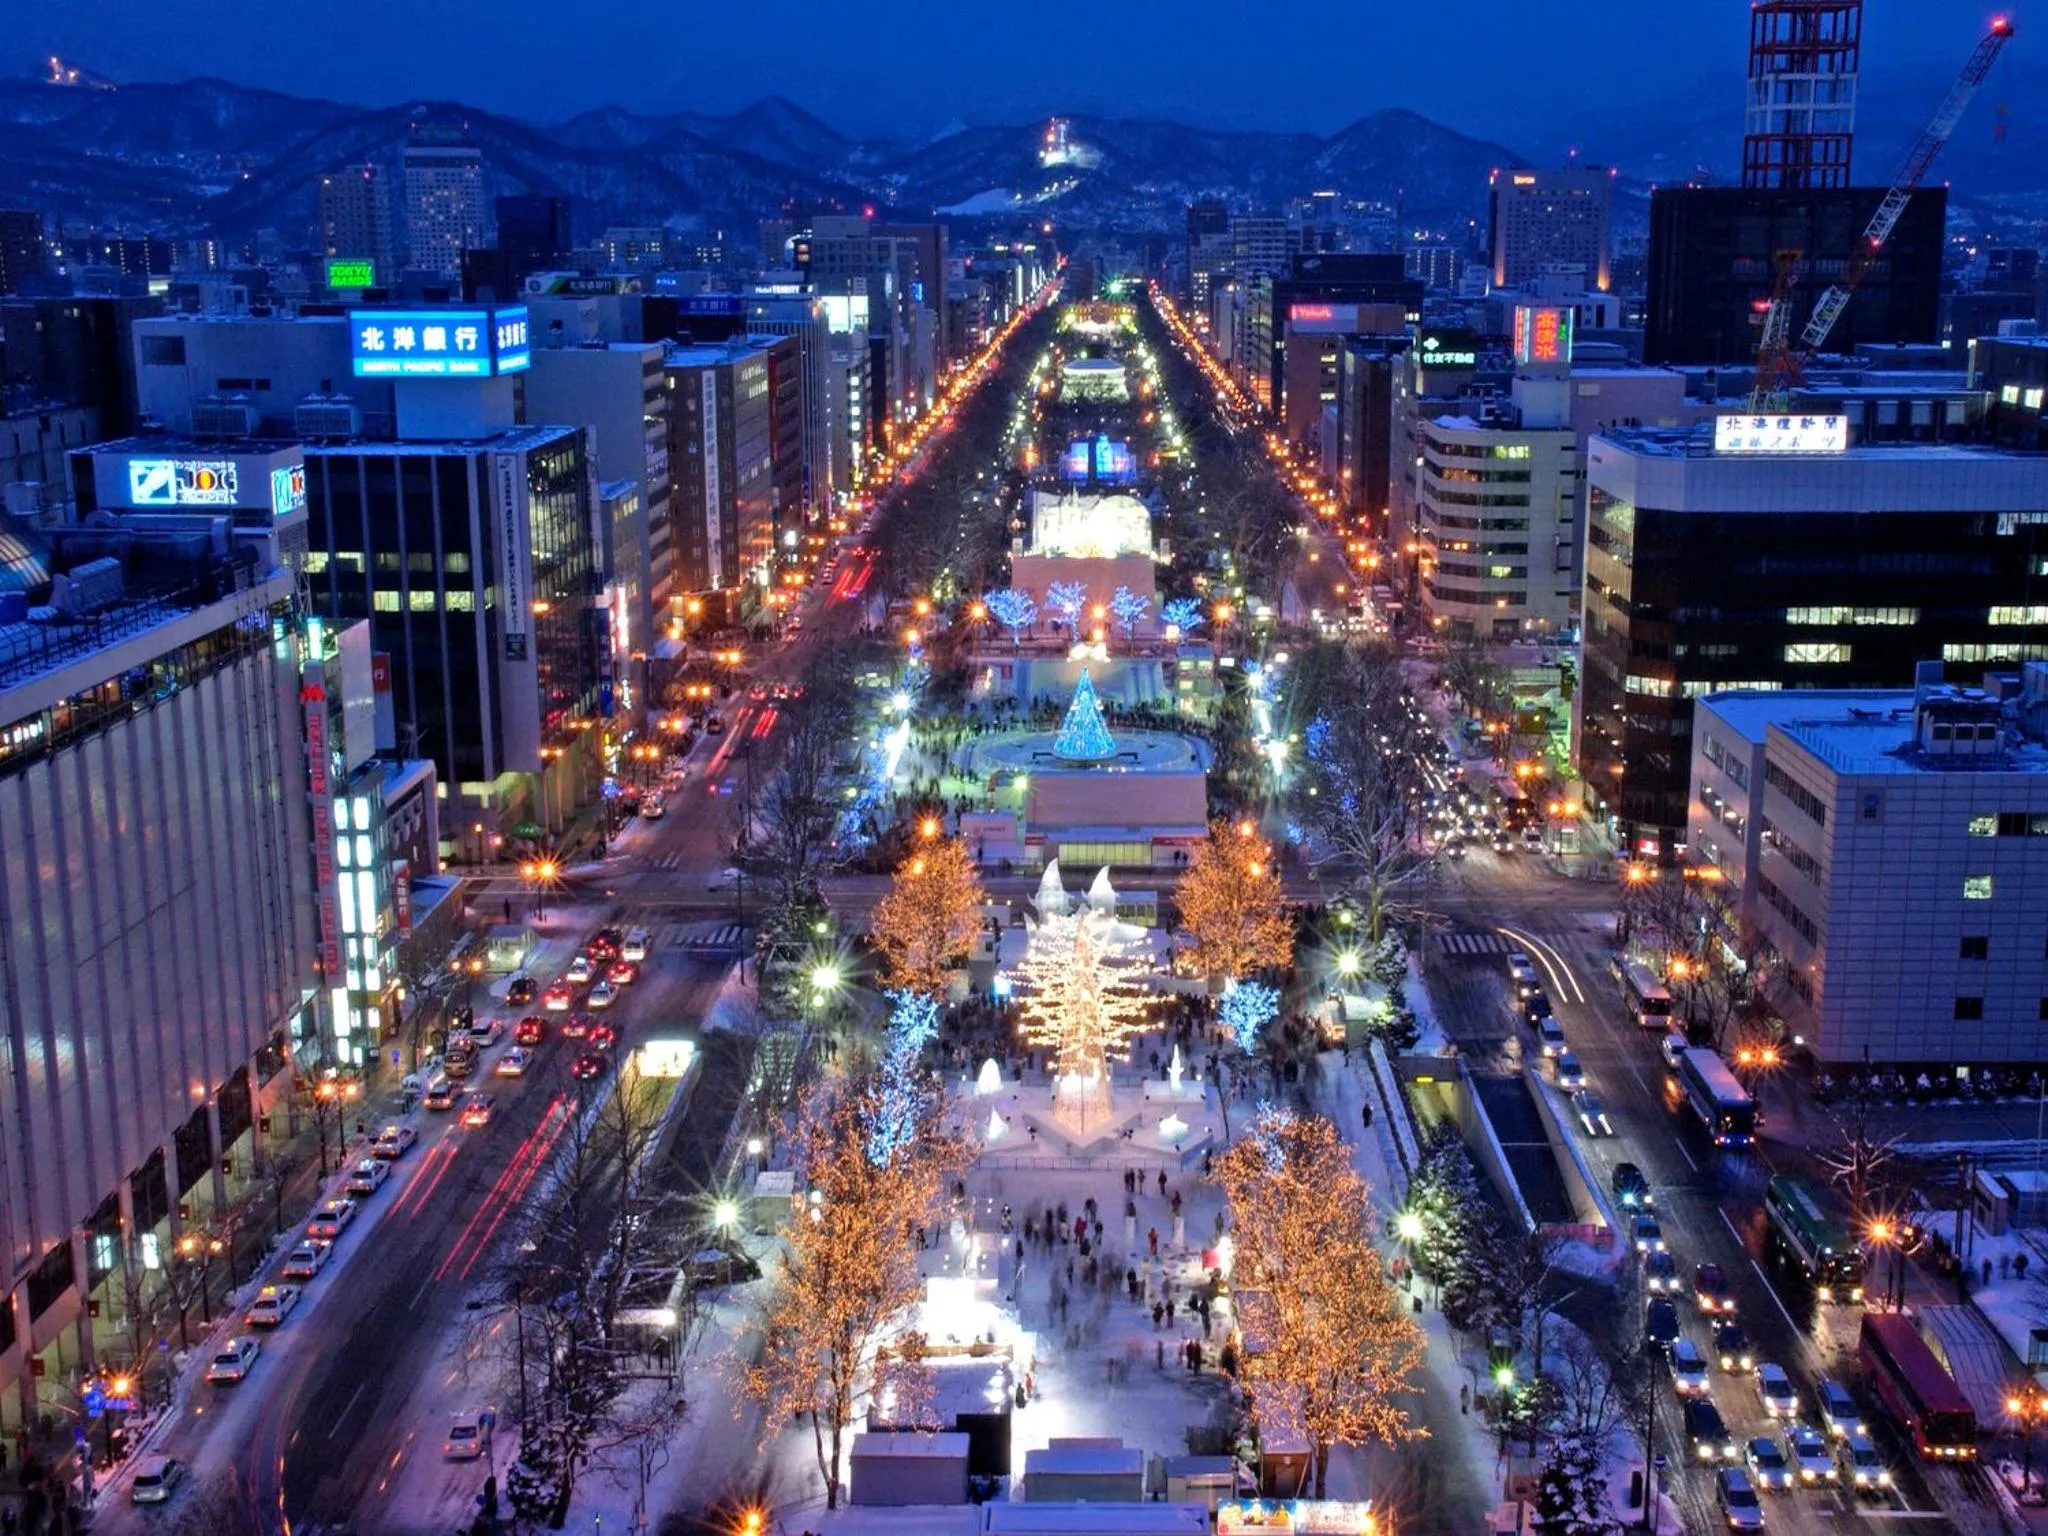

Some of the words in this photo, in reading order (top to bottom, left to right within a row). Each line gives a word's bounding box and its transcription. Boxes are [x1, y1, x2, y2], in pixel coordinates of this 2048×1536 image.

[329, 266, 371, 276] TOKYU
[361, 326, 478, 351] 北洋銀行
[1726, 417, 1838, 430] 北海道新聞
